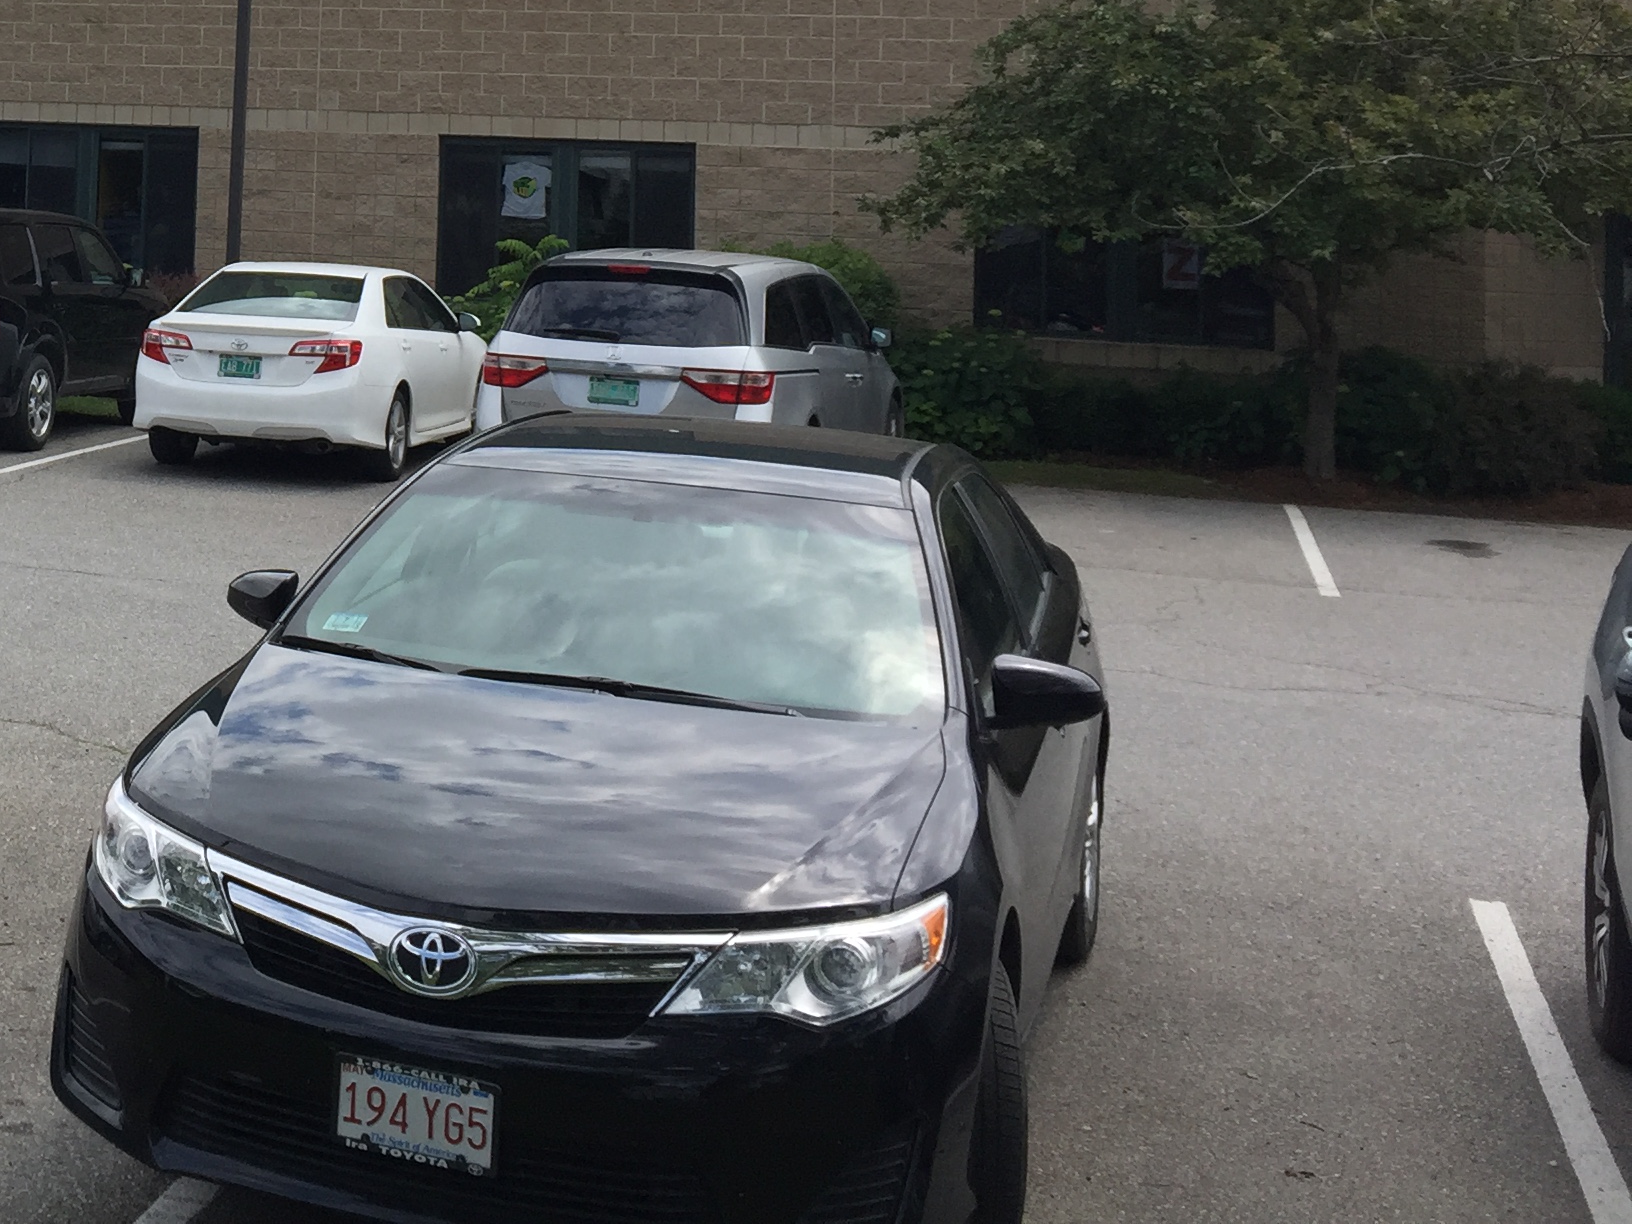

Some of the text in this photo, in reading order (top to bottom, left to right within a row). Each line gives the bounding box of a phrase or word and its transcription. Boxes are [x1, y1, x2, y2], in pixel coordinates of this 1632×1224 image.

[356, 1057, 480, 1090] 1-866-CALL IRA
[372, 1068, 463, 1097] Massachusetts
[343, 1081, 488, 1151] 194 YG5
[345, 1138, 449, 1169] Ira TOYOTA
